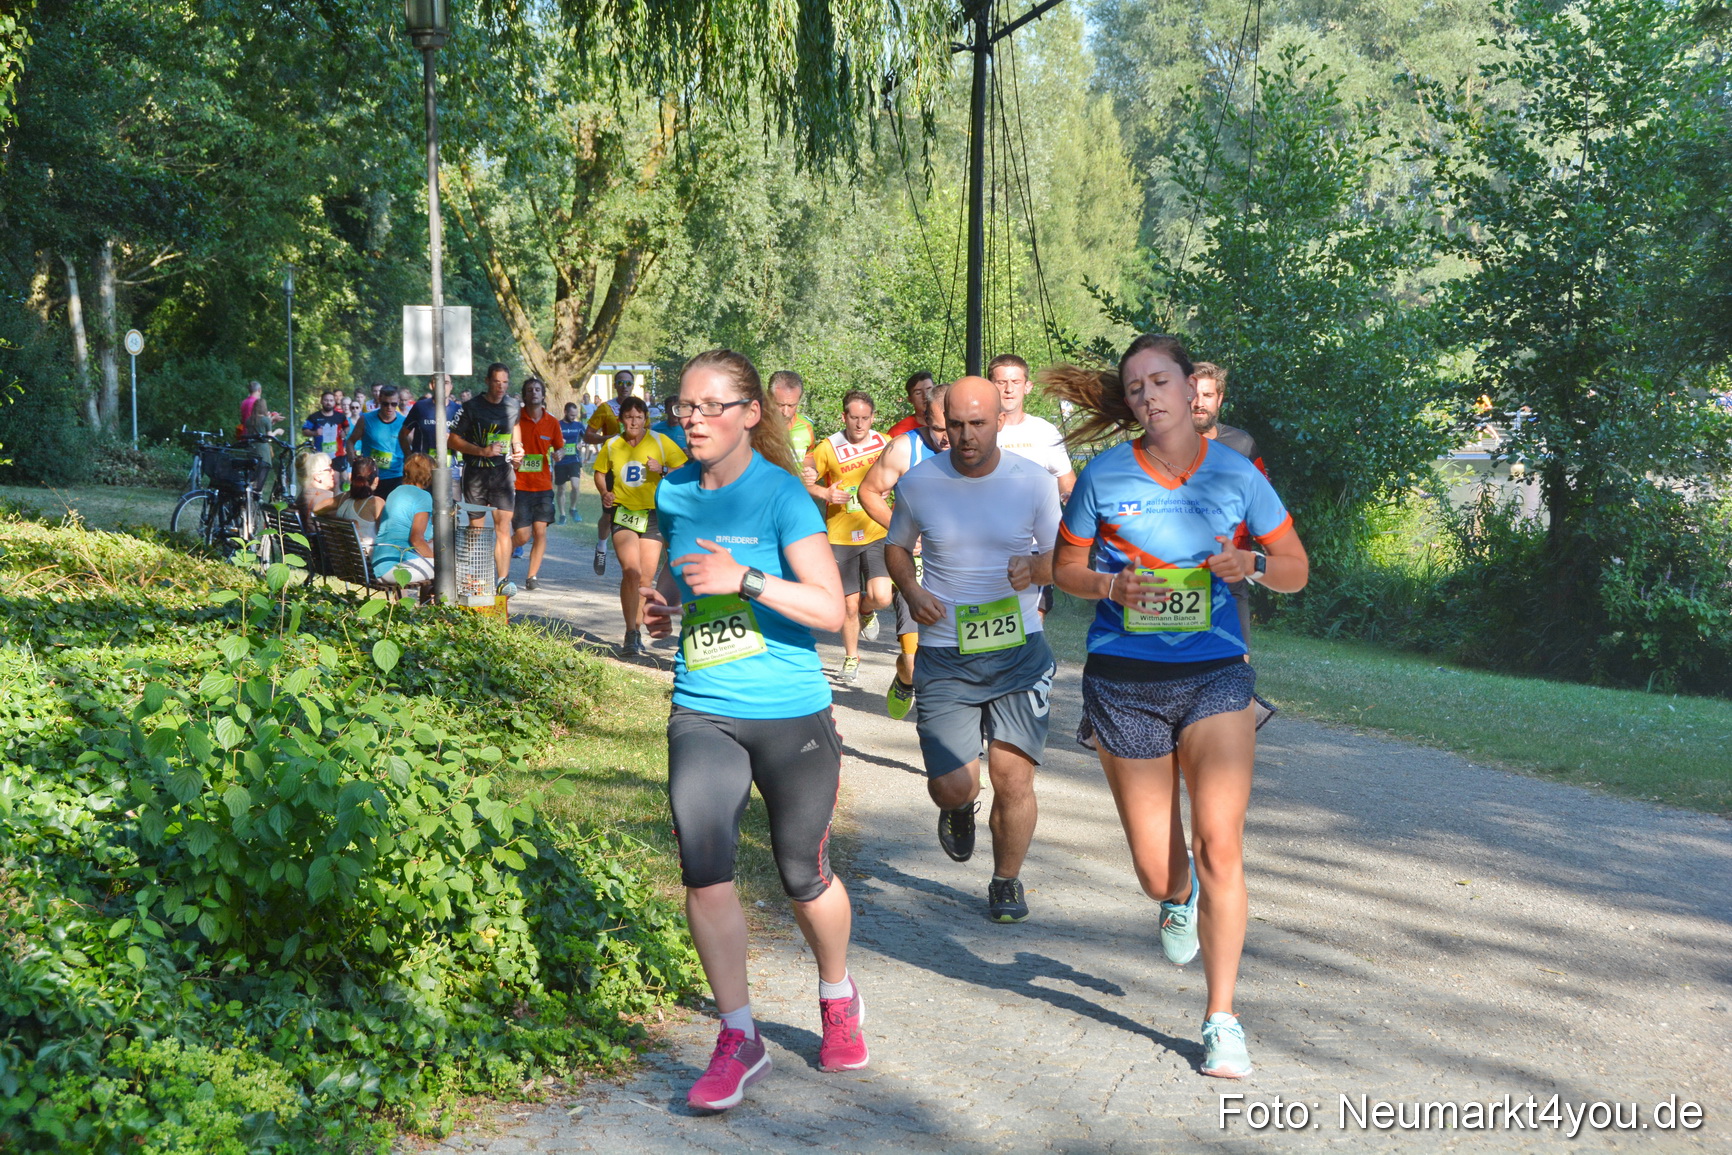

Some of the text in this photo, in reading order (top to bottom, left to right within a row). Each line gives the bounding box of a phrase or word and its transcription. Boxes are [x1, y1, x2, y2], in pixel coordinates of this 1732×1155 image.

[840, 454, 881, 474] MAX BÖ
[1146, 498, 1200, 506] Raiffeisenbank
[621, 513, 639, 526] 241
[721, 535, 759, 545] PFLEIDERER
[688, 615, 747, 650] 1526
[966, 615, 1016, 640] 2125
[703, 643, 736, 656] Korb Irene
